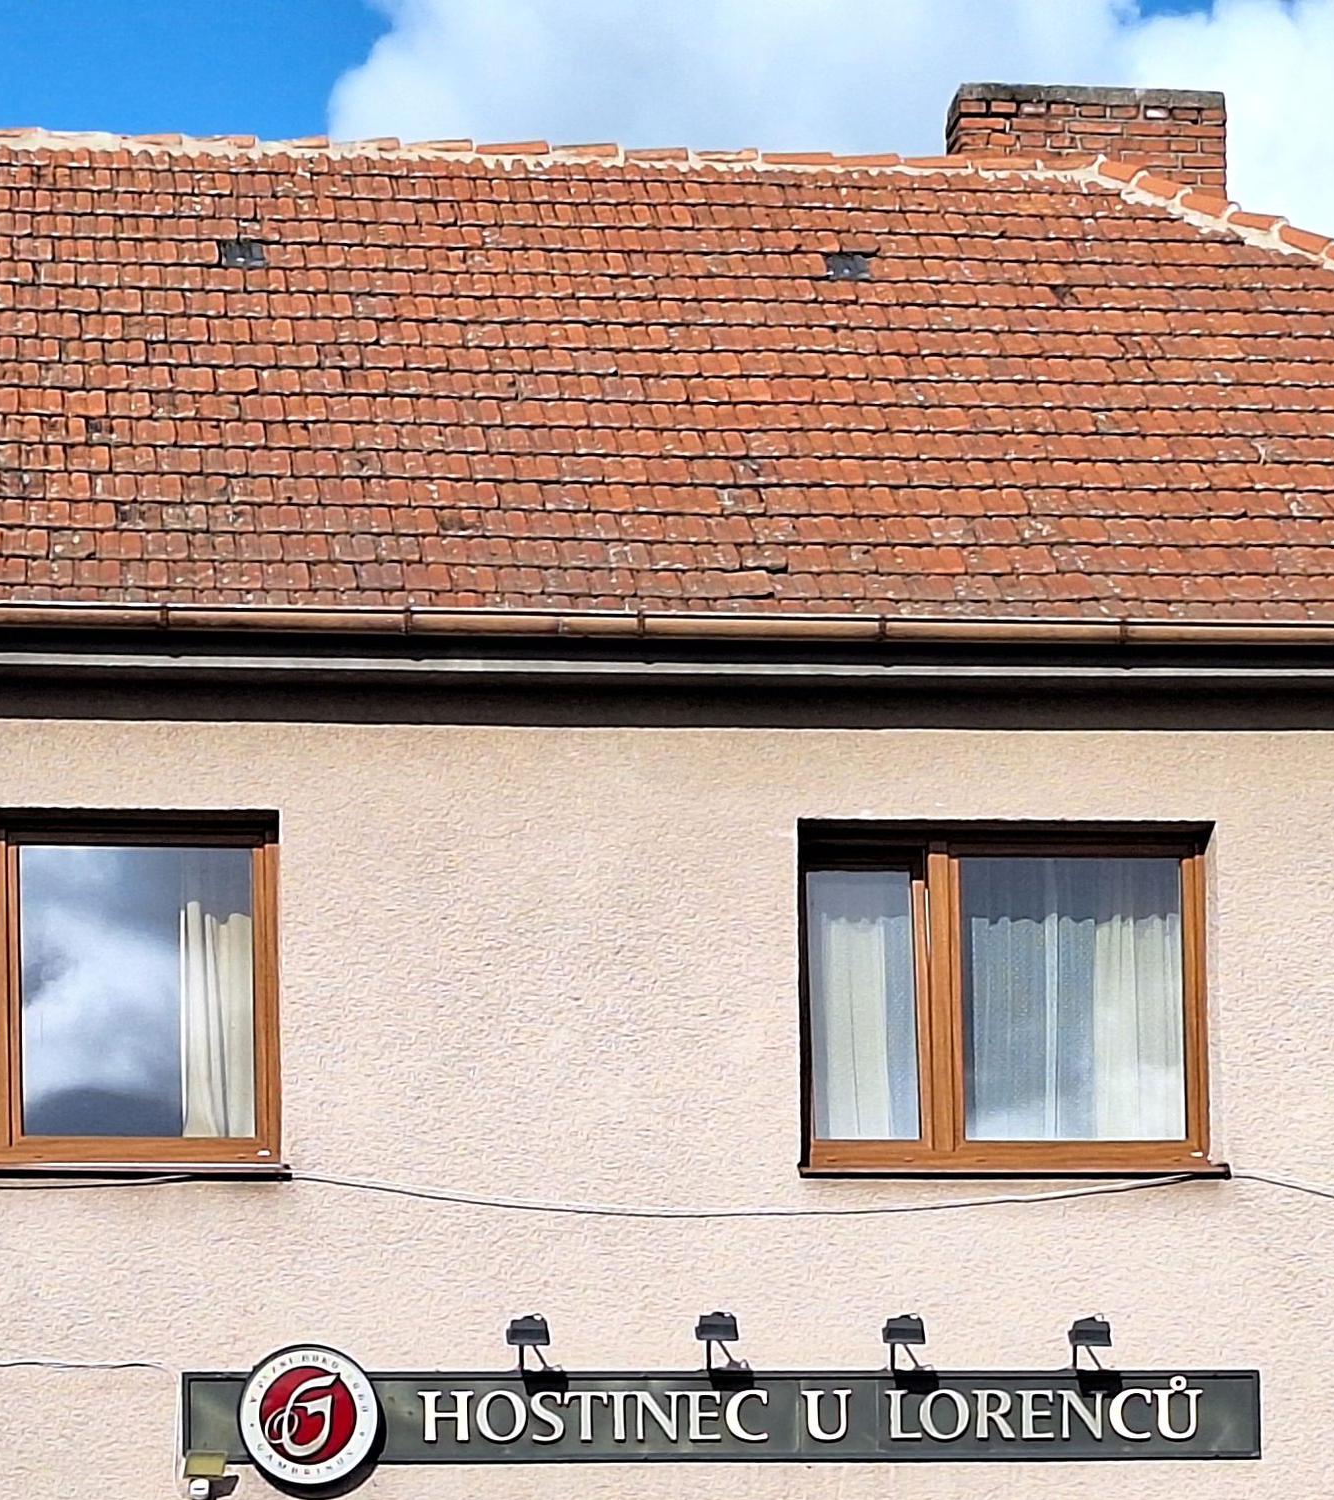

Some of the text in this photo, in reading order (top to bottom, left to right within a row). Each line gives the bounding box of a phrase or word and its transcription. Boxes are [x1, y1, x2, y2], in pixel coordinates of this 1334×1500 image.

[417, 1389, 769, 1442] HOSTINEC
[800, 1389, 853, 1441] U
[884, 1375, 1204, 1441] LORENCŮ
